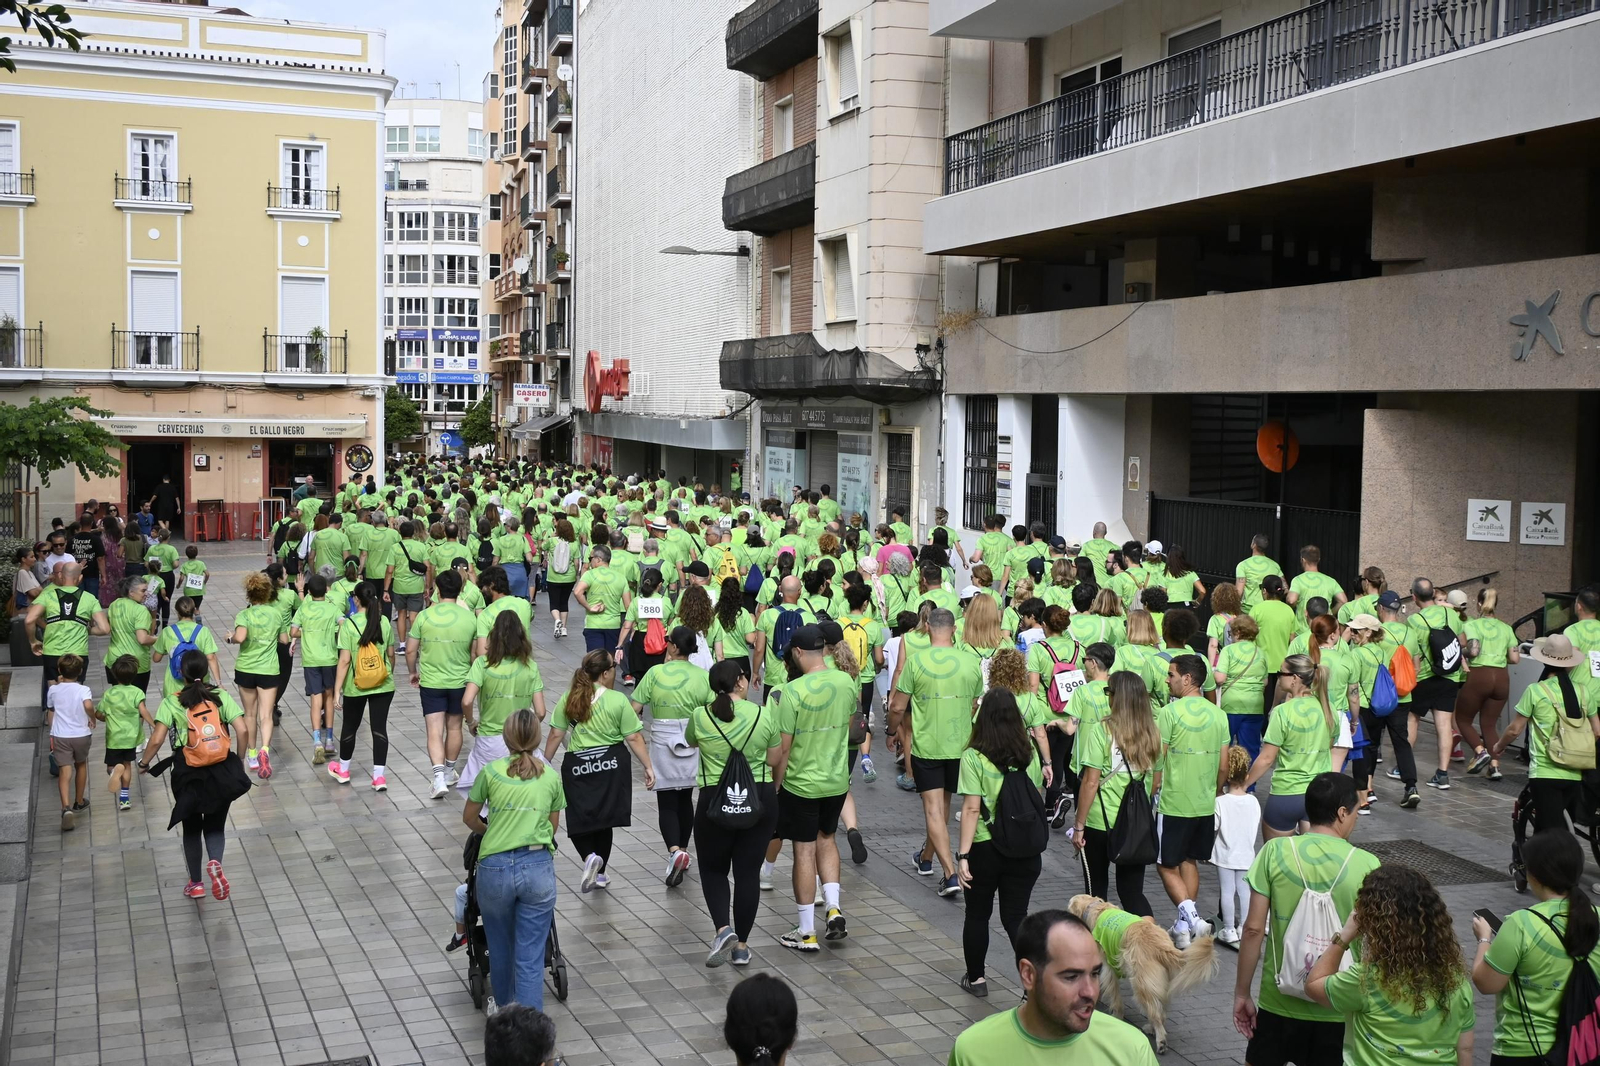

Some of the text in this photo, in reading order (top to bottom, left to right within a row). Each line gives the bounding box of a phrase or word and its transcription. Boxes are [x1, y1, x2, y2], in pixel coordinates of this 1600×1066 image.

[158, 424, 204, 434] CERVECERIAS
[250, 426, 304, 435] EL GALLO NEGRO
[1442, 637, 1460, 661] NIKE
[572, 759, 618, 776] adidas
[722, 805, 752, 813] addas
